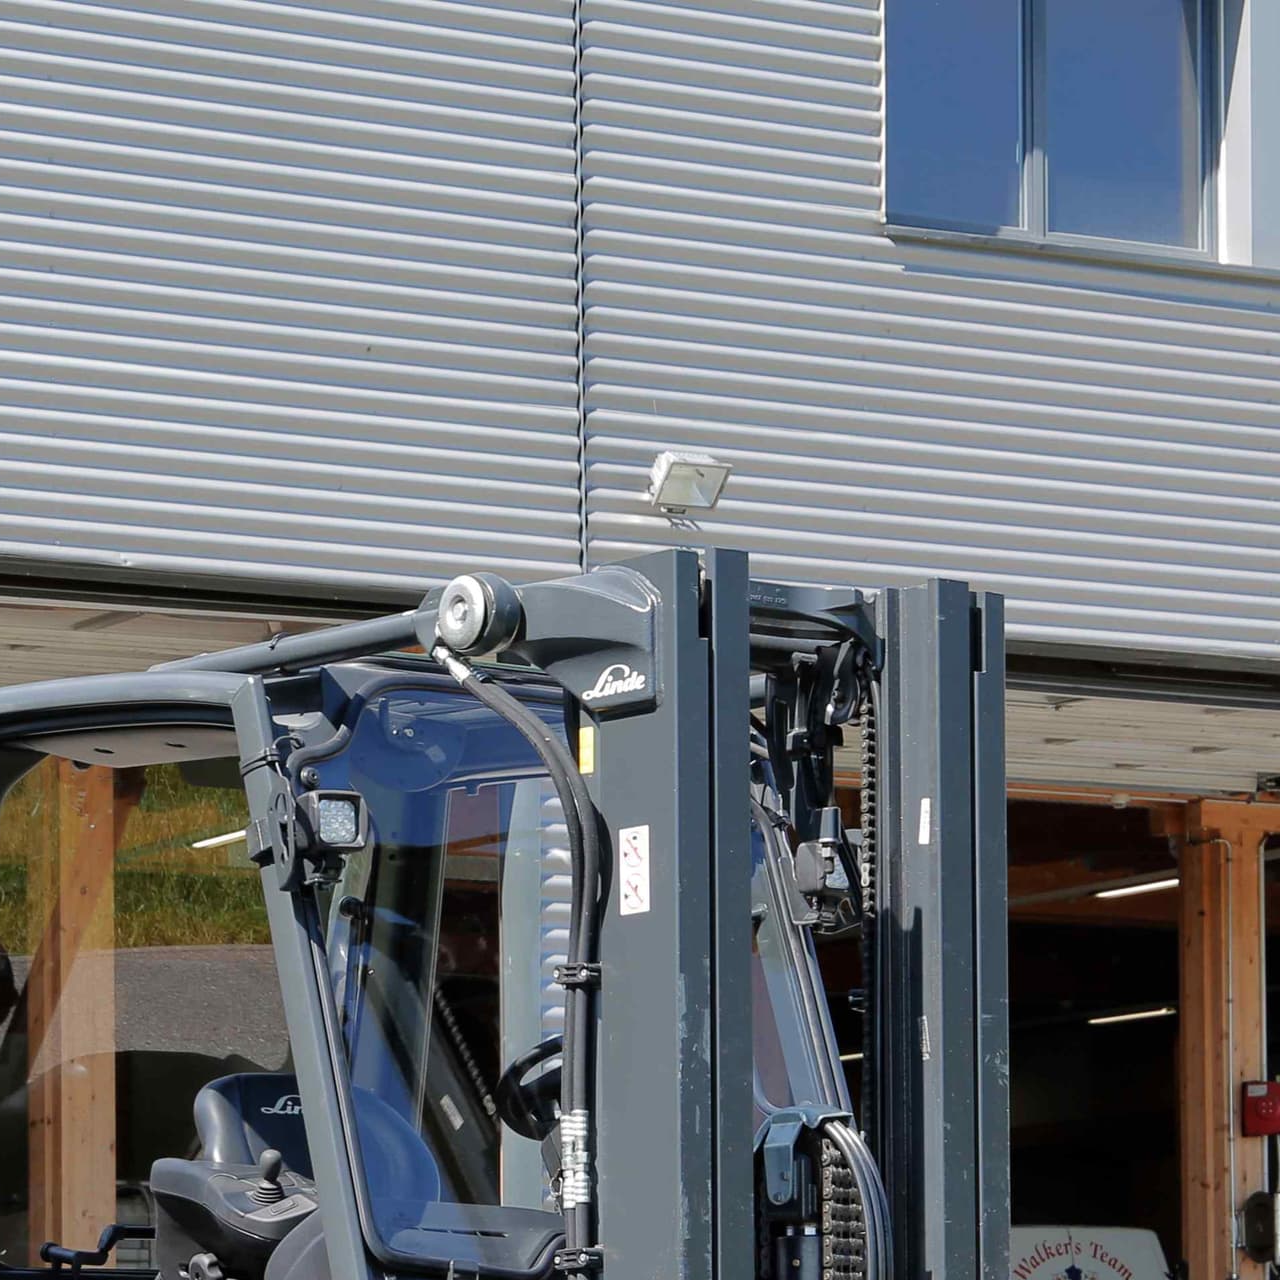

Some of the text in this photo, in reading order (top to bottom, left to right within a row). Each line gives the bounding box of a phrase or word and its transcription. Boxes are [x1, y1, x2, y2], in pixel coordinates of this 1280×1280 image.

[582, 664, 646, 700] Linde
[261, 1095, 302, 1114] Lin
[1013, 1238, 1082, 1280] Walker's
